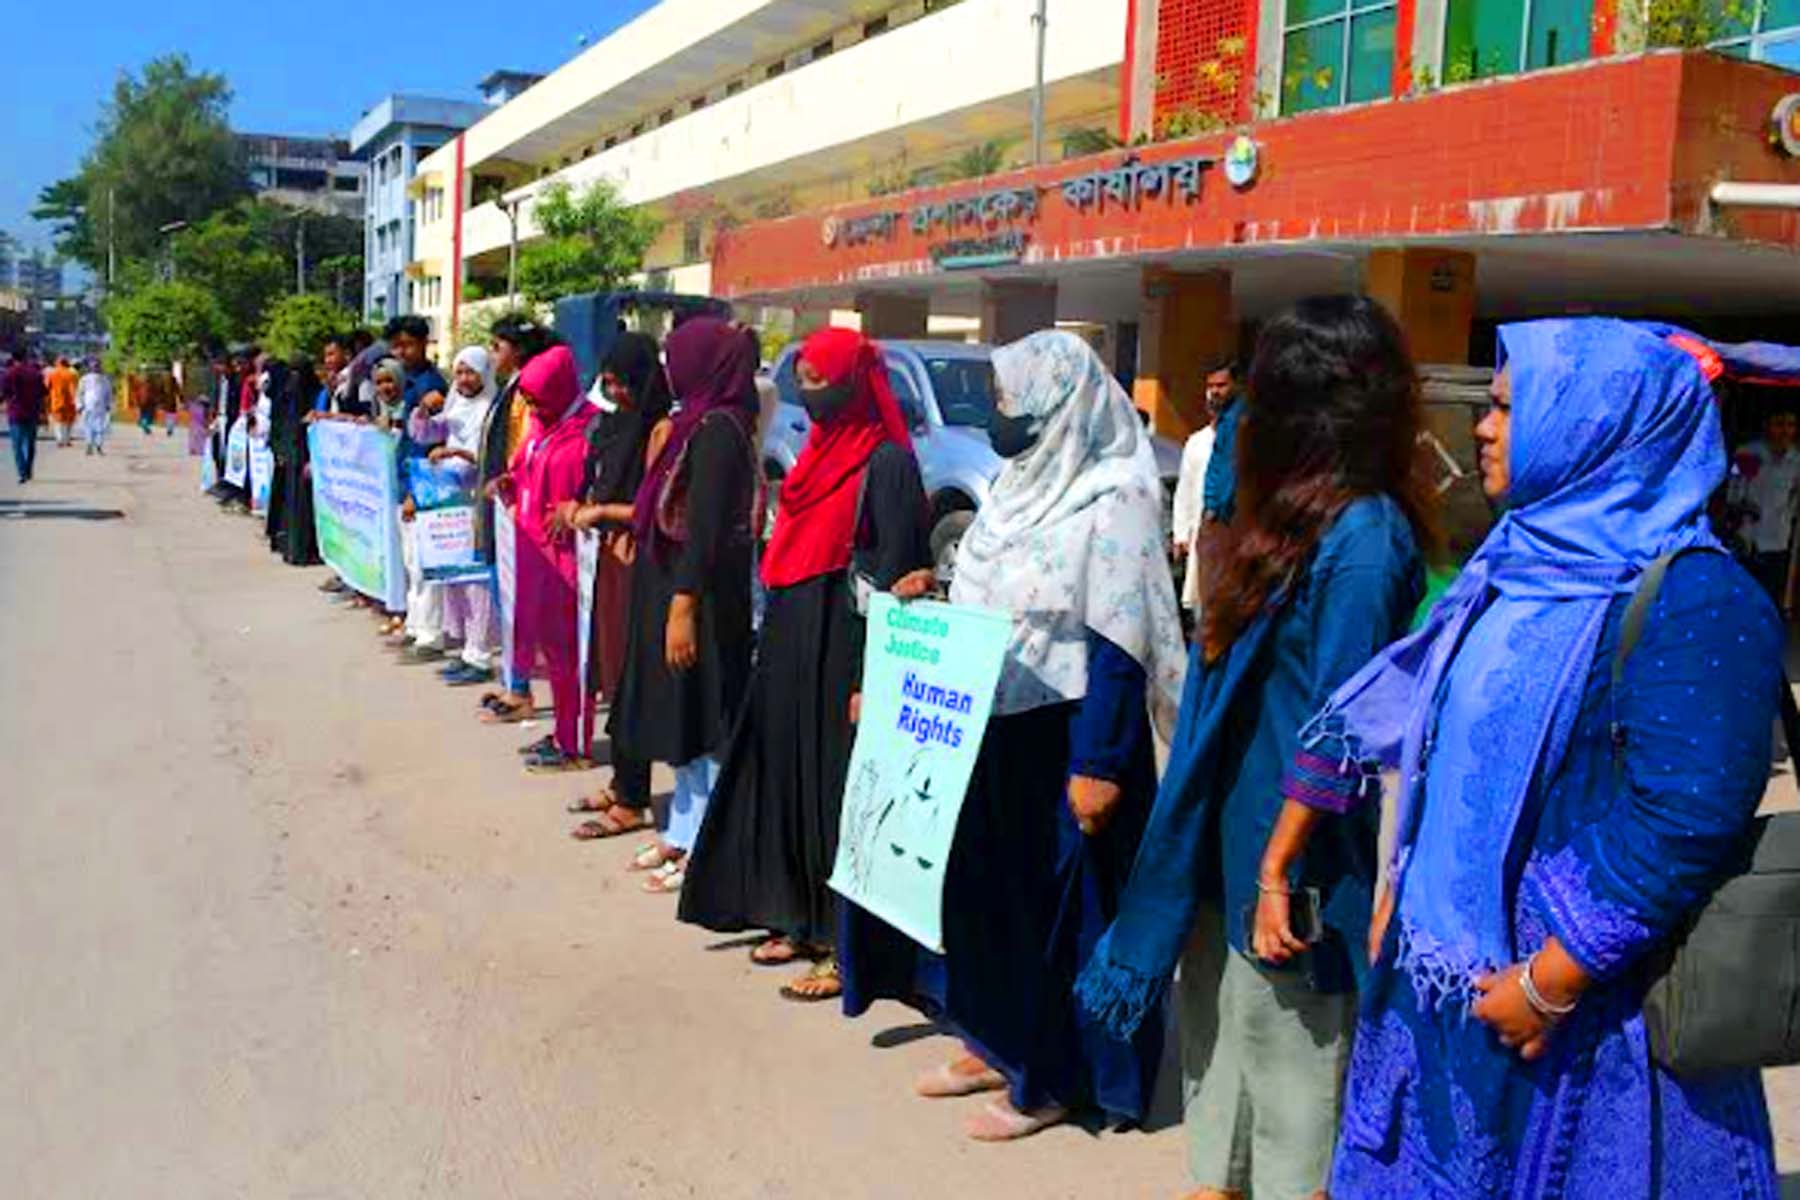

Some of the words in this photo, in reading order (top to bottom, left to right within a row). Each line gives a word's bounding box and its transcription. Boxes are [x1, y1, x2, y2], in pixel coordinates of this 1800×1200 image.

[887, 606, 948, 637] Climate
[885, 634, 940, 664] Justice
[902, 672, 973, 713] Human
[898, 705, 964, 747] Rights
